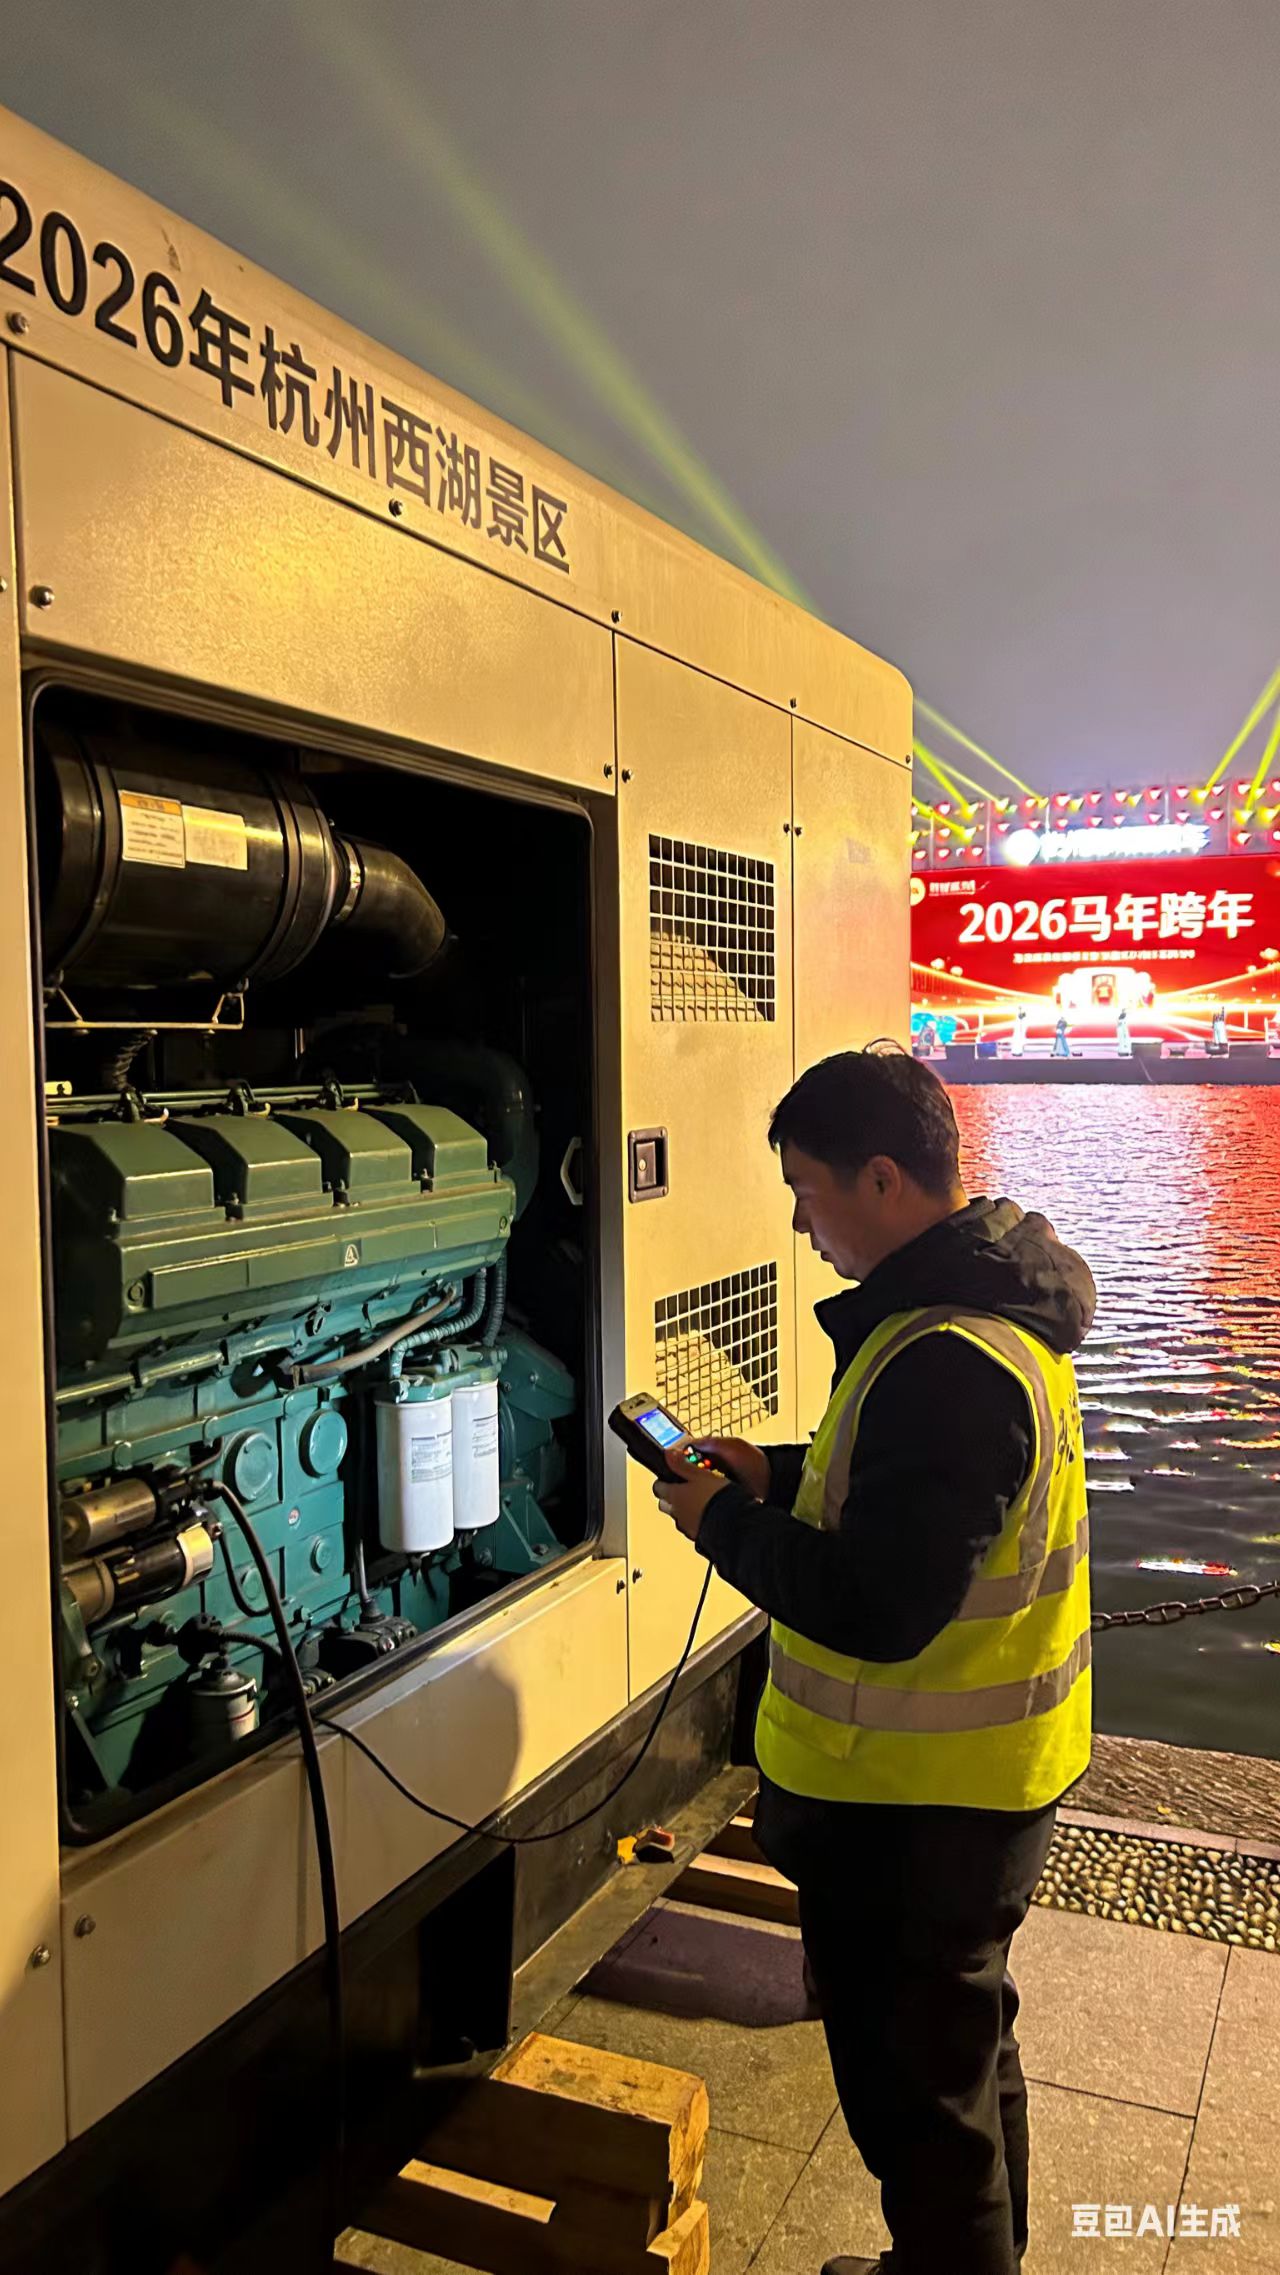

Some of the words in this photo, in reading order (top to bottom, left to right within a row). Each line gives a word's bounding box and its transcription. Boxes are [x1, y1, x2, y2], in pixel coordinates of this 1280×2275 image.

[0, 180, 570, 574] 2026年杭州西湖景区
[958, 889, 1255, 944] 2026马年跨年
